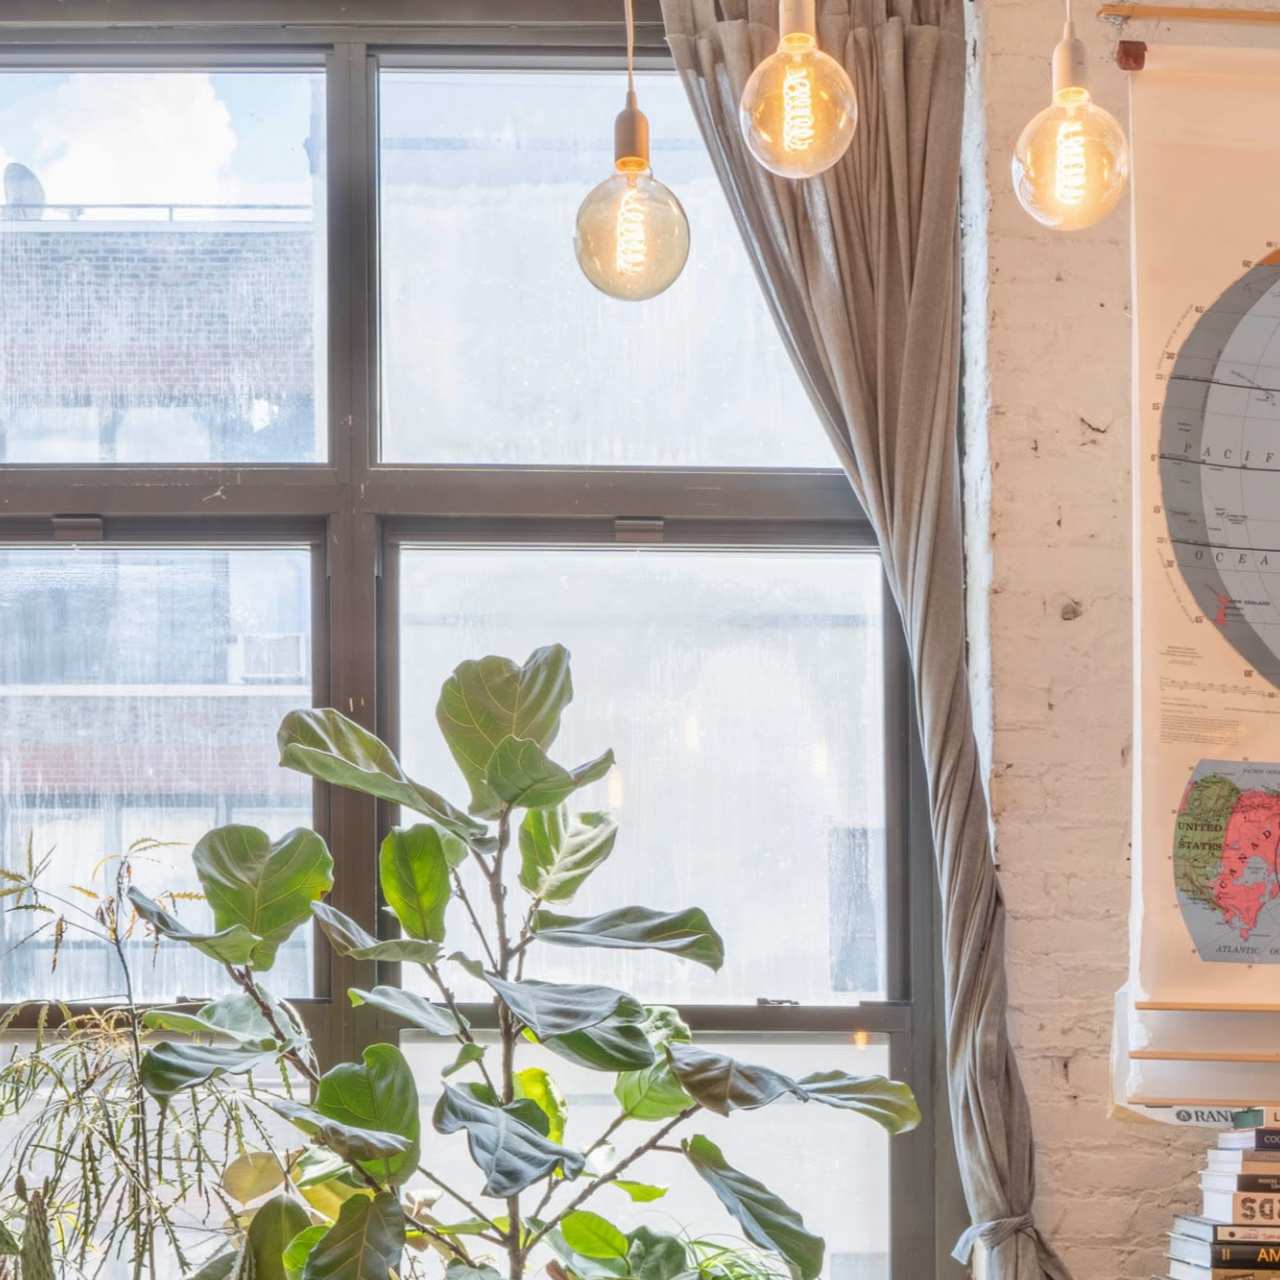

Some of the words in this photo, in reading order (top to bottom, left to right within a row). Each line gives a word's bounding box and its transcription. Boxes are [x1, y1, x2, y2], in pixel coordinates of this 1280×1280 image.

[1177, 822, 1223, 832] UNITED
[1178, 841, 1222, 850] STATES
[1194, 1109, 1236, 1123] RAN
